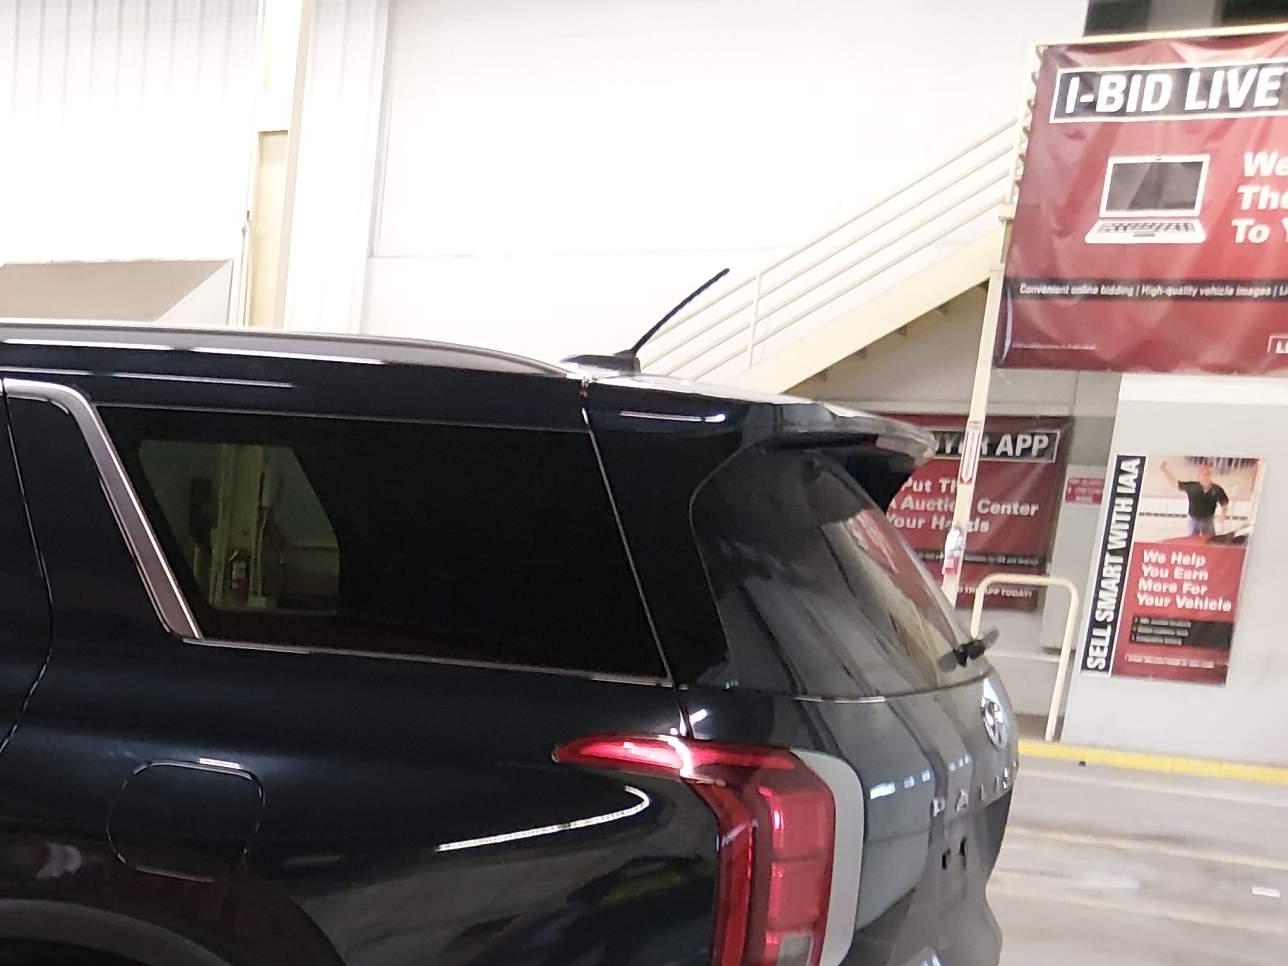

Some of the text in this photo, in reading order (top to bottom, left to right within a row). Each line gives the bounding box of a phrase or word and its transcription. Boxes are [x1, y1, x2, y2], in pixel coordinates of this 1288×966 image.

[1065, 66, 1283, 114] I-BID LIVE
[1231, 217, 1270, 244] To
[1020, 283, 1069, 296] Convenient
[1070, 284, 1099, 295] online
[1100, 283, 1134, 297] bidding
[1140, 284, 1198, 298] High-quality
[1199, 284, 1234, 297] vehicle
[1235, 284, 1272, 298] images
[995, 433, 1049, 458] APP
[977, 499, 1040, 517] Center
[1086, 458, 1140, 670] SELL SMART WITH IAA
[1142, 549, 1206, 567] We Help
[1142, 564, 1209, 581] You Earn
[1138, 578, 1208, 596] More For
[1136, 593, 1232, 612] Your Vehicle
